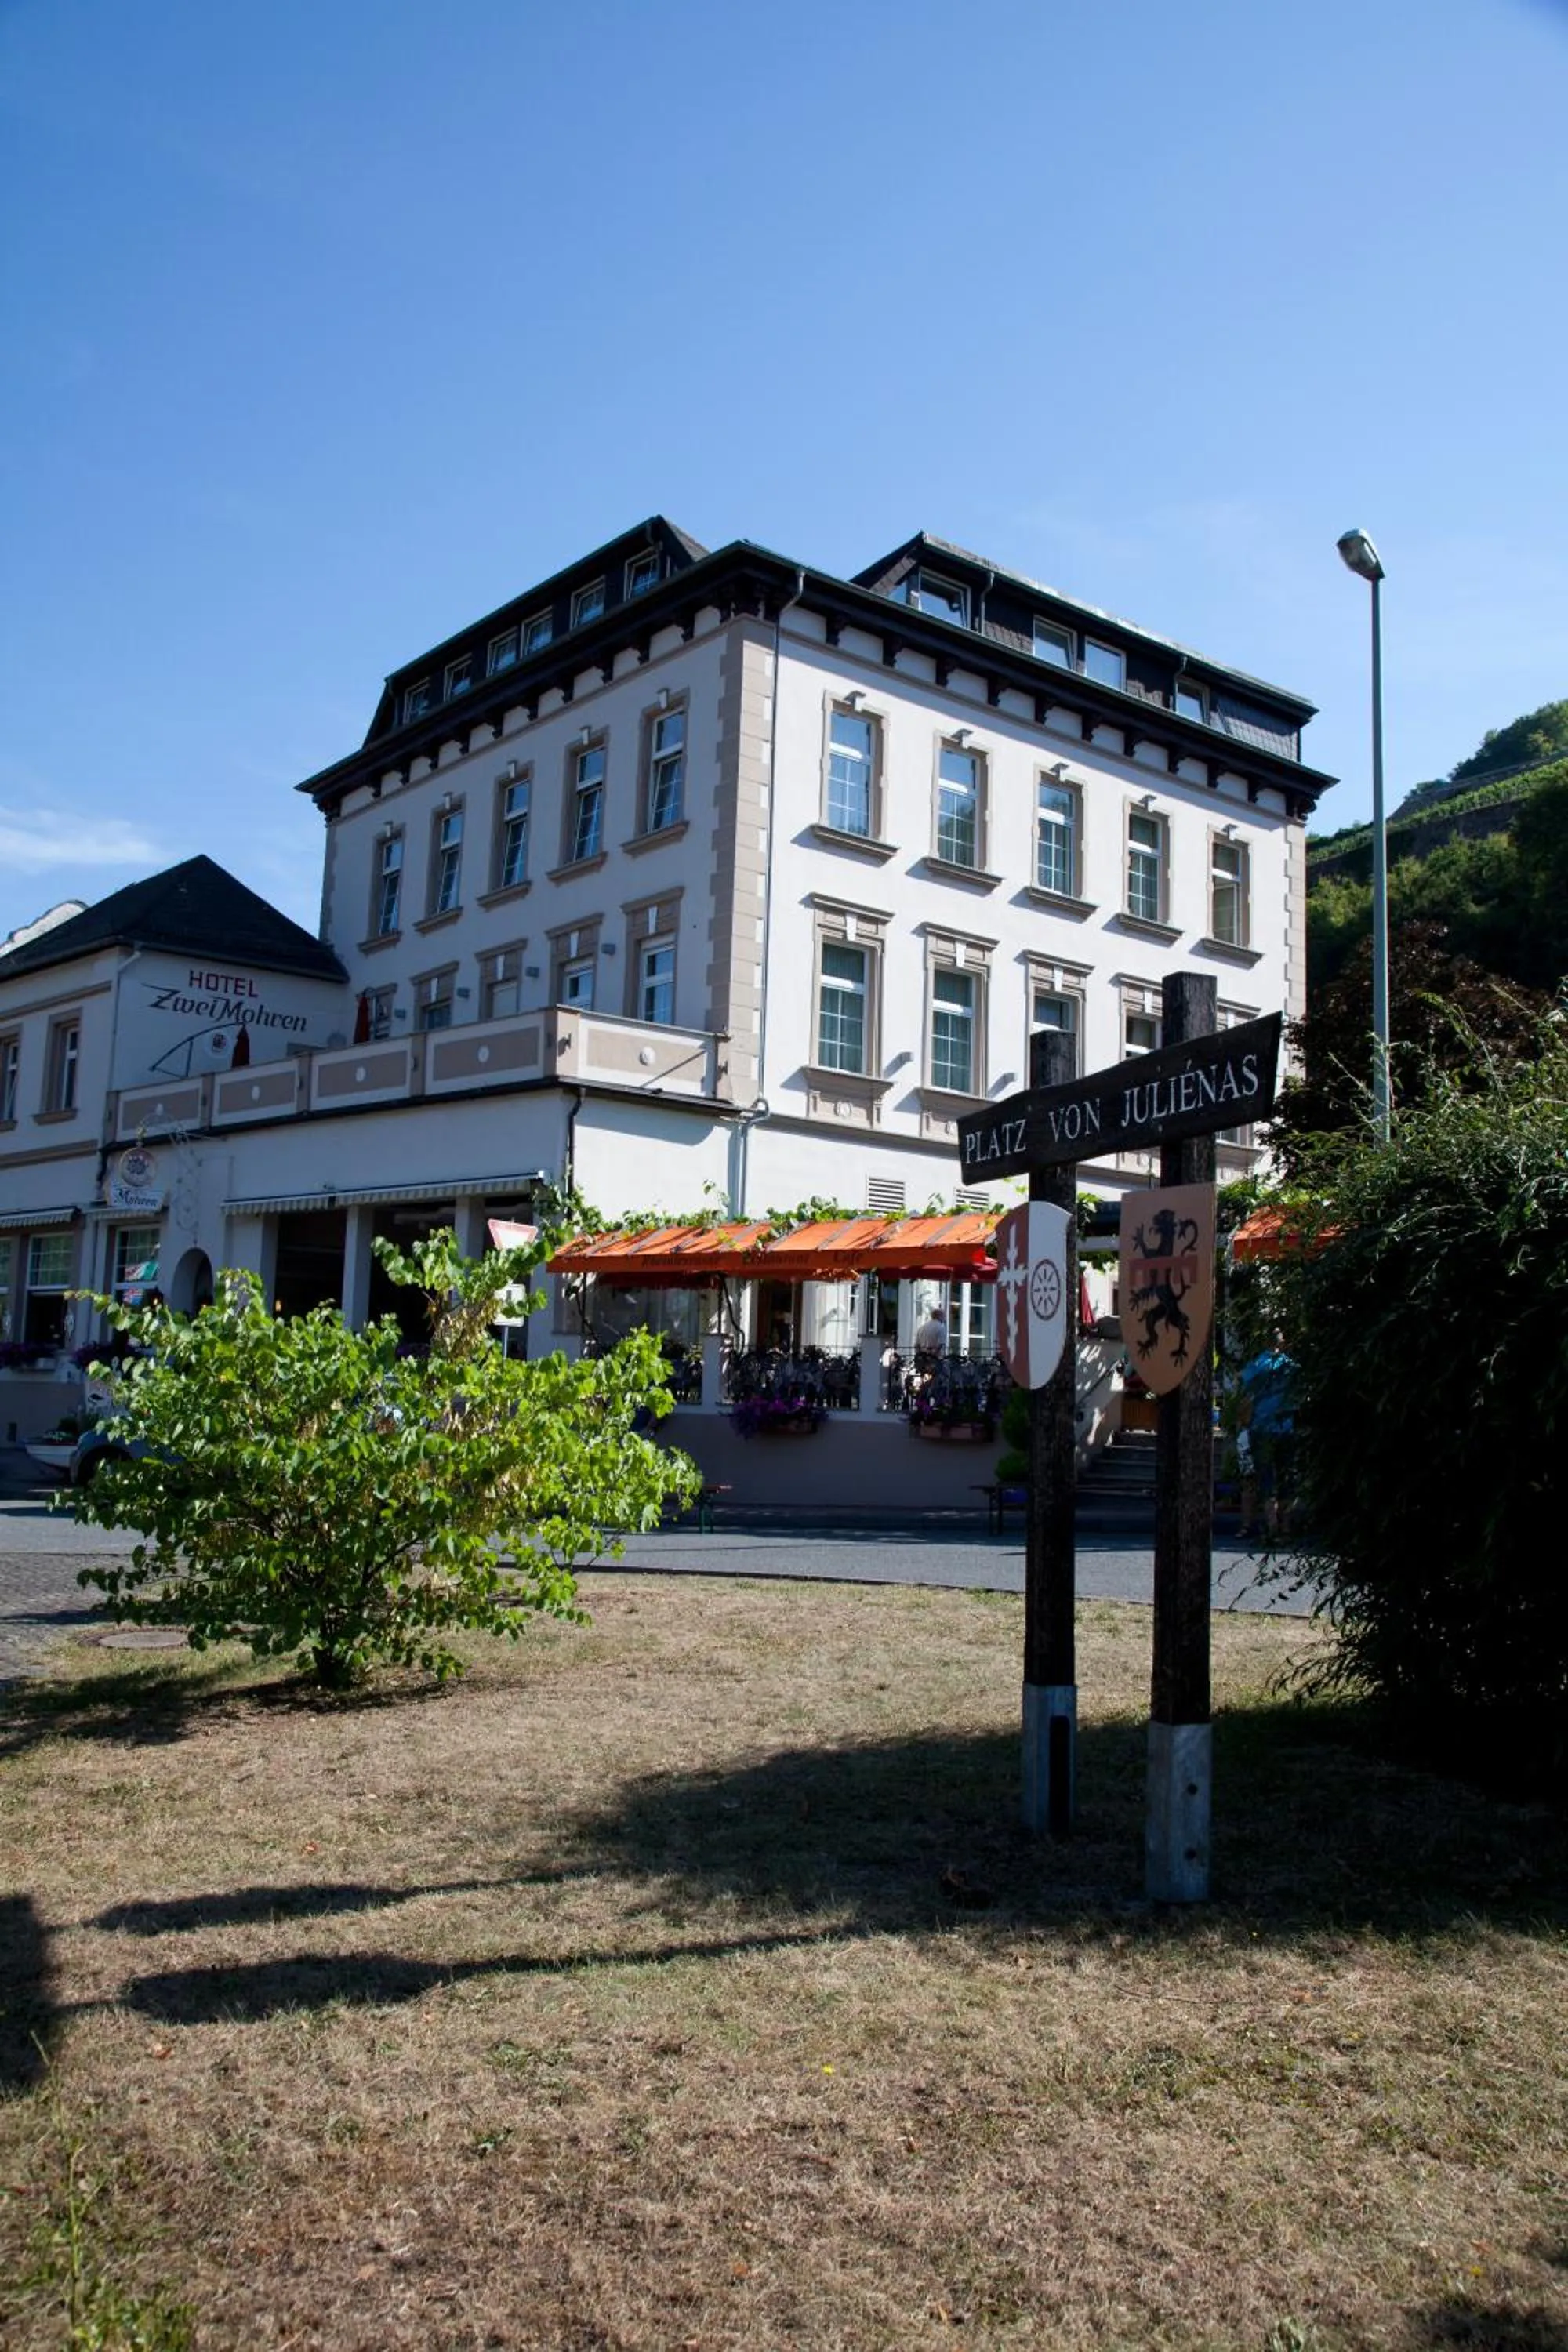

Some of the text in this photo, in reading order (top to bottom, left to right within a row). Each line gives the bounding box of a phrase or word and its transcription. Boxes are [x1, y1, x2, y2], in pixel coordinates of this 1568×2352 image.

[140, 982, 307, 1032] Zwei Mohren
[189, 969, 259, 998] HOTEL
[965, 1054, 1259, 1165] PLATZ VON JULIÉNAS
